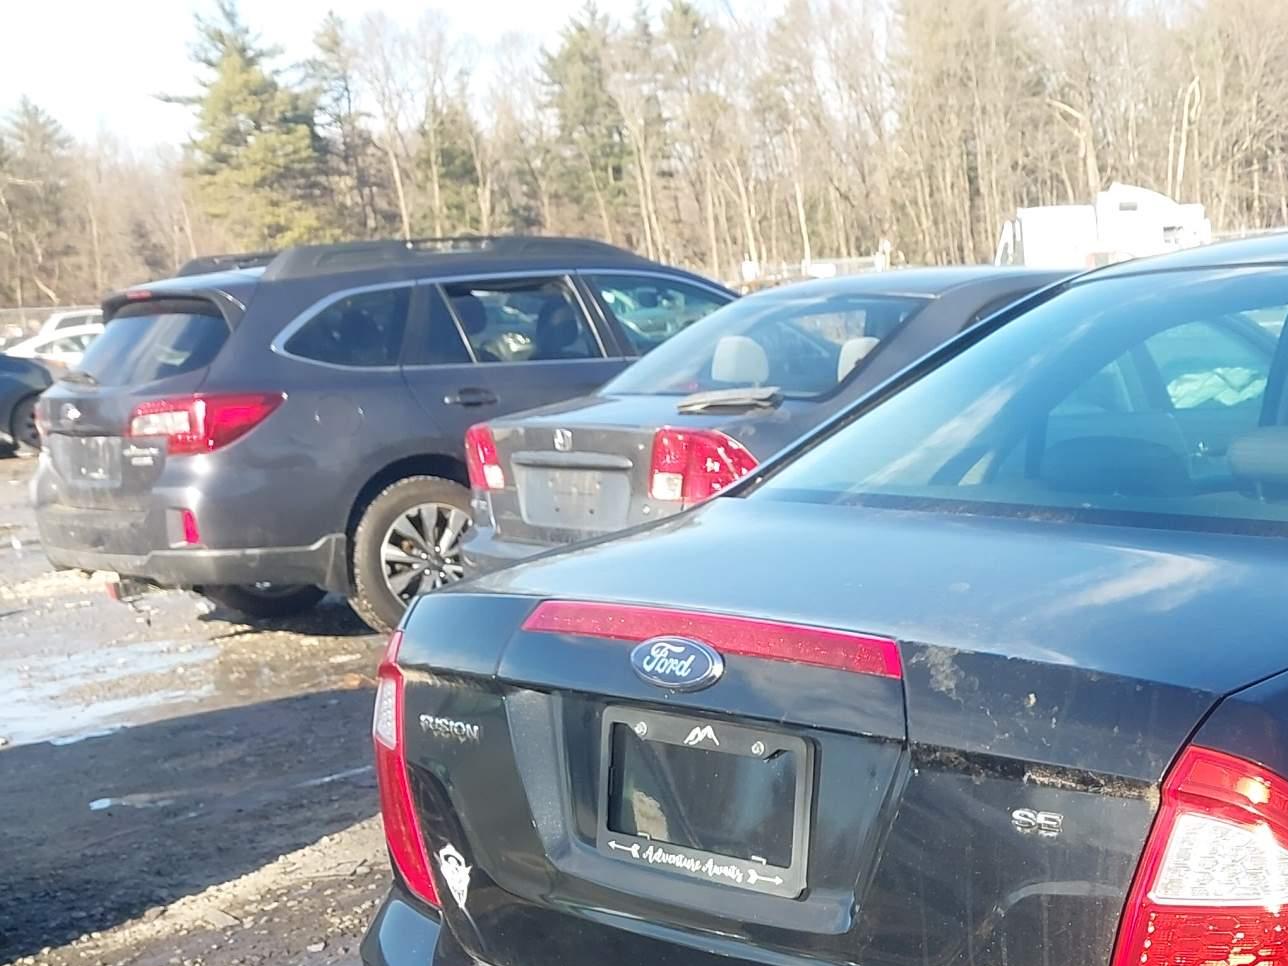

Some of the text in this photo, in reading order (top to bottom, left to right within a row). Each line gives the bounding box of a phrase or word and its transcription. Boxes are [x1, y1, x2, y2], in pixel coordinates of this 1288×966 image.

[642, 642, 696, 677] Ford
[419, 714, 479, 740] FUSION
[1010, 808, 1064, 834] SE
[642, 845, 744, 883] Adventure Awaits
